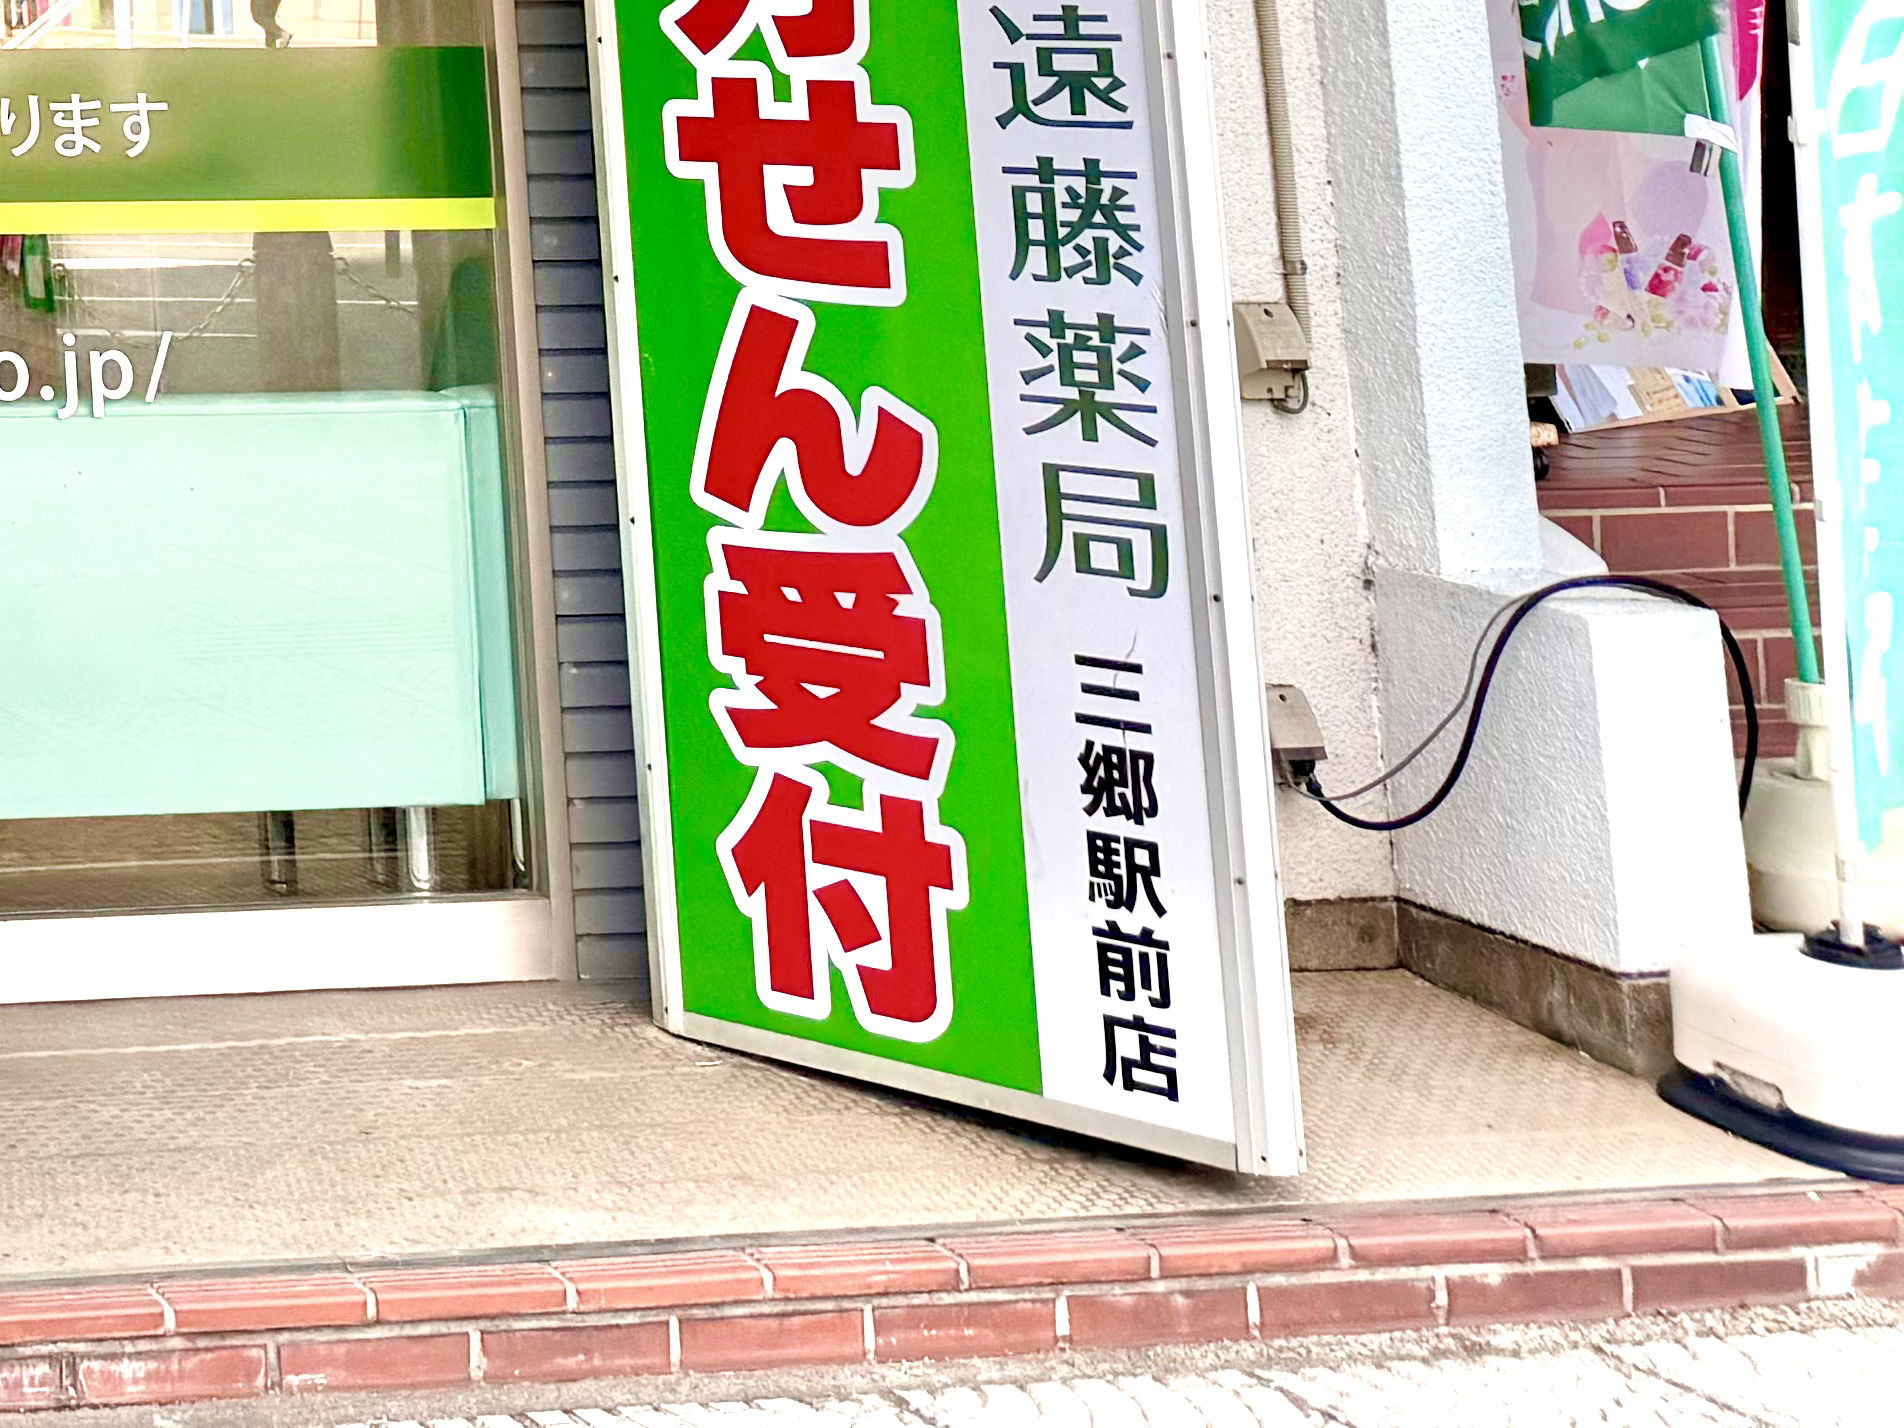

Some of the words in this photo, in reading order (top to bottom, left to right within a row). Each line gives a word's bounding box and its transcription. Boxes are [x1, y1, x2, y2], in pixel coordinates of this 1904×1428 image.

[993, 2, 1170, 601] 遠藤薬局
[1072, 652, 1178, 1106] 三郷駅前店
